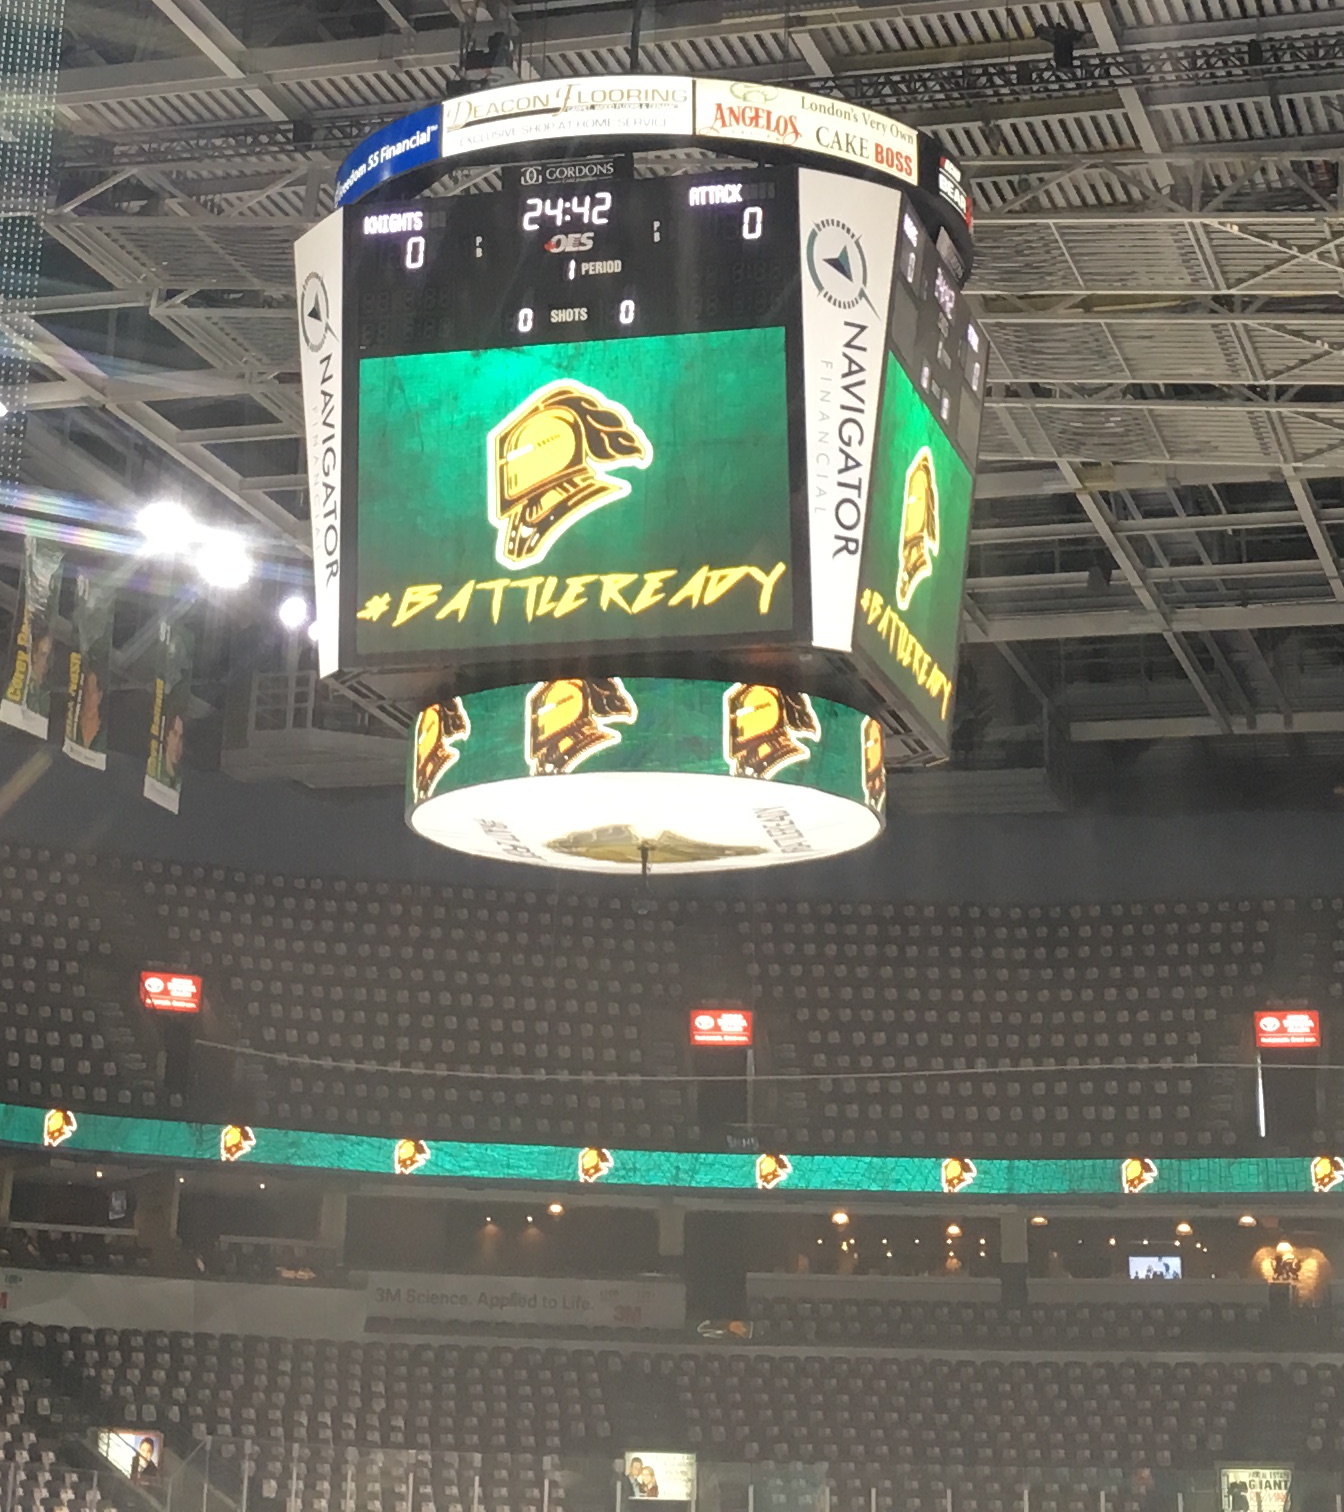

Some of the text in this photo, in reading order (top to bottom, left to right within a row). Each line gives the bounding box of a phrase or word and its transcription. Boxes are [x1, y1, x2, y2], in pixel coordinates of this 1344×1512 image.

[861, 111, 888, 132] Very
[890, 123, 914, 146] Own
[367, 150, 380, 170] 55
[815, 126, 870, 161] CAKE
[874, 142, 914, 178] BOSS
[545, 163, 614, 180] GORDONS
[689, 183, 743, 206] ATTACK
[363, 211, 423, 235] KNIGHTS
[522, 191, 612, 231] 24:42
[742, 206, 763, 240] 0
[405, 236, 426, 270] 0
[549, 232, 594, 253] OES
[581, 260, 622, 276] PERIOD
[518, 307, 534, 333] 0
[550, 308, 588, 323] SHOTS
[619, 299, 635, 325] 0
[814, 359, 834, 514] FINANCIAL
[832, 320, 869, 560] NAVIGATOR
[319, 352, 339, 588] NAVIGATOR
[356, 562, 786, 628] #BATTLEREADY
[859, 587, 953, 720] #BATTLEREADY
[477, 1291, 538, 1311] Applied
[542, 1293, 558, 1309] to
[1248, 1479, 1289, 1490] GIANT
